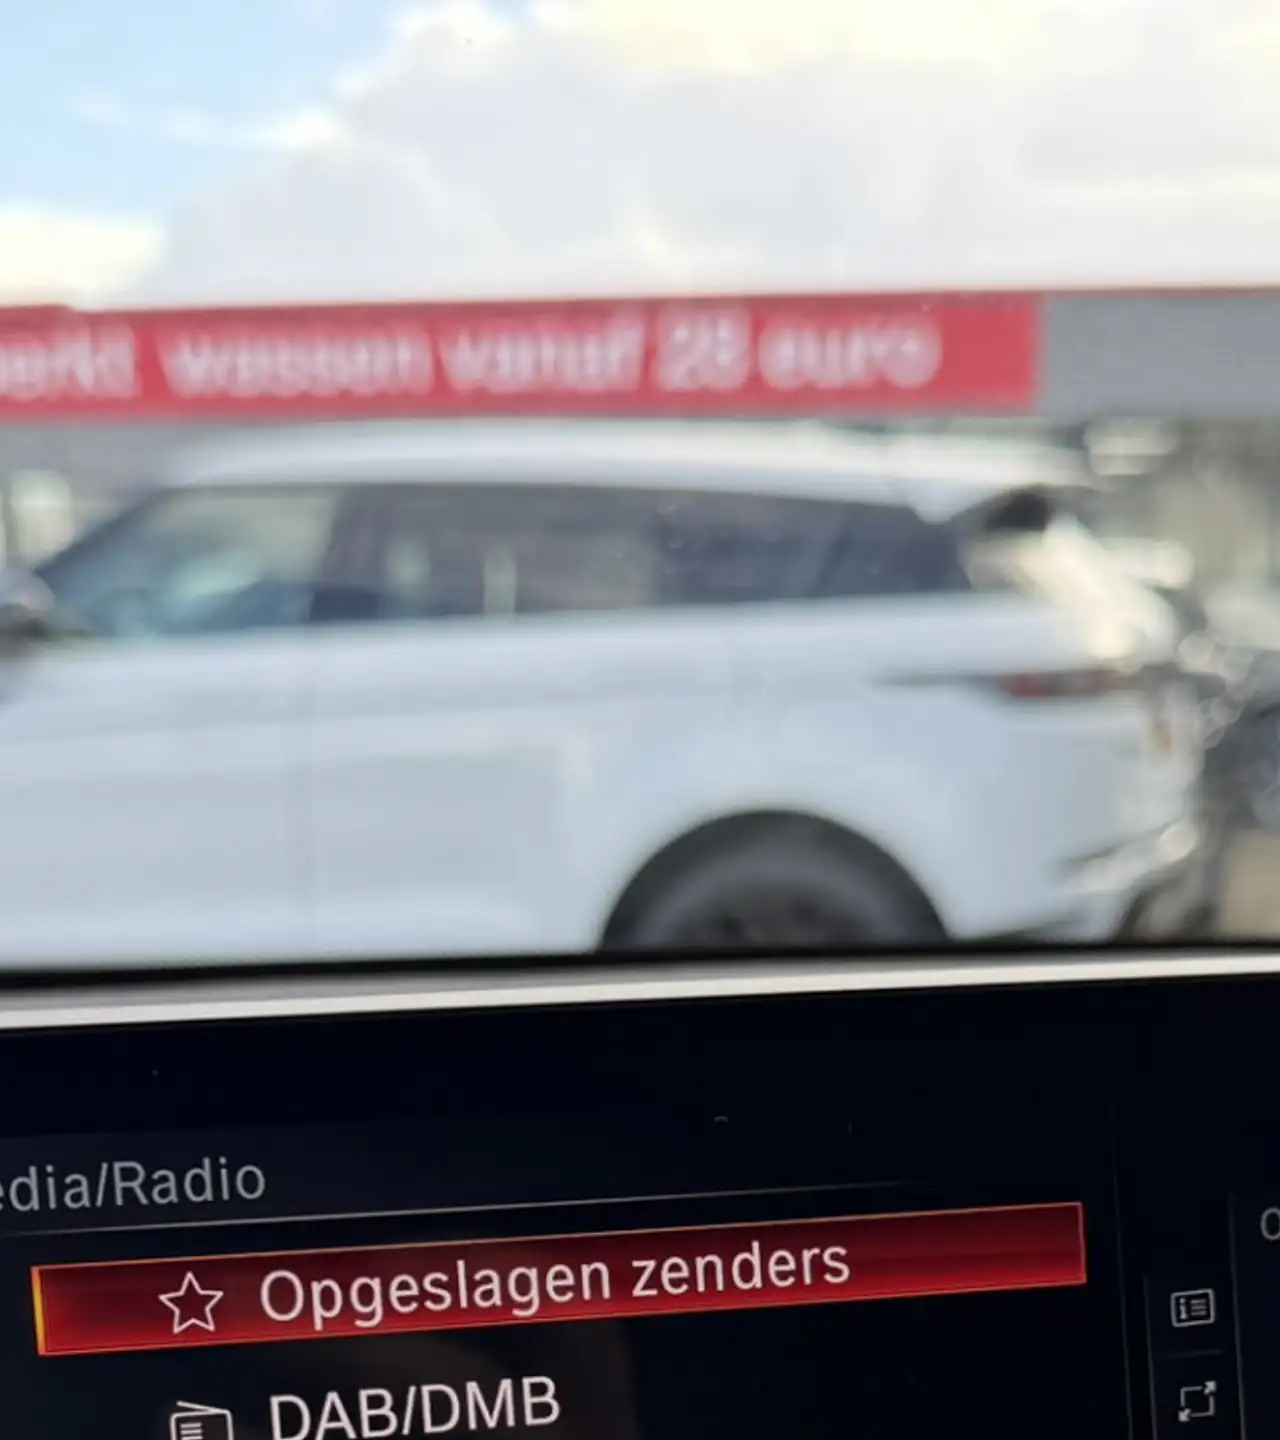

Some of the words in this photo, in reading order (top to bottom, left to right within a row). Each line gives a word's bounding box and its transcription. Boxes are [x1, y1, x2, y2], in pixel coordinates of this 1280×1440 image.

[158, 322, 432, 398] wassen
[437, 306, 645, 394] vanaf
[760, 312, 942, 391] euro
[260, 1258, 611, 1331] Opgeslagen
[631, 1240, 851, 1298] zenders
